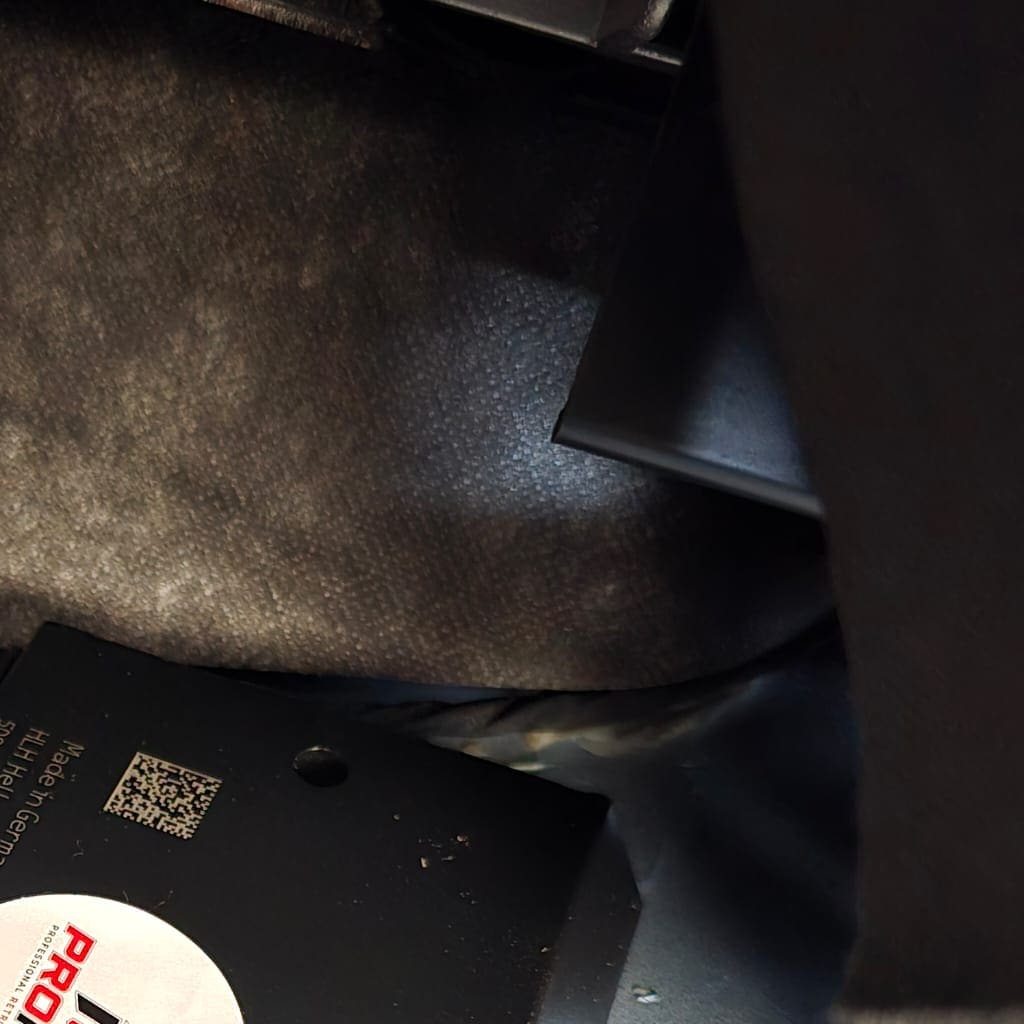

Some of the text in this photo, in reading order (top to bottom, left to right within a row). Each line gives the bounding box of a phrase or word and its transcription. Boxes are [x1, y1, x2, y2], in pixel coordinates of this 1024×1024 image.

[12, 727, 50, 762] HLH
[37, 739, 85, 787] Made
[24, 789, 53, 807] in
[13, 924, 60, 992] PROFESSIONAL
